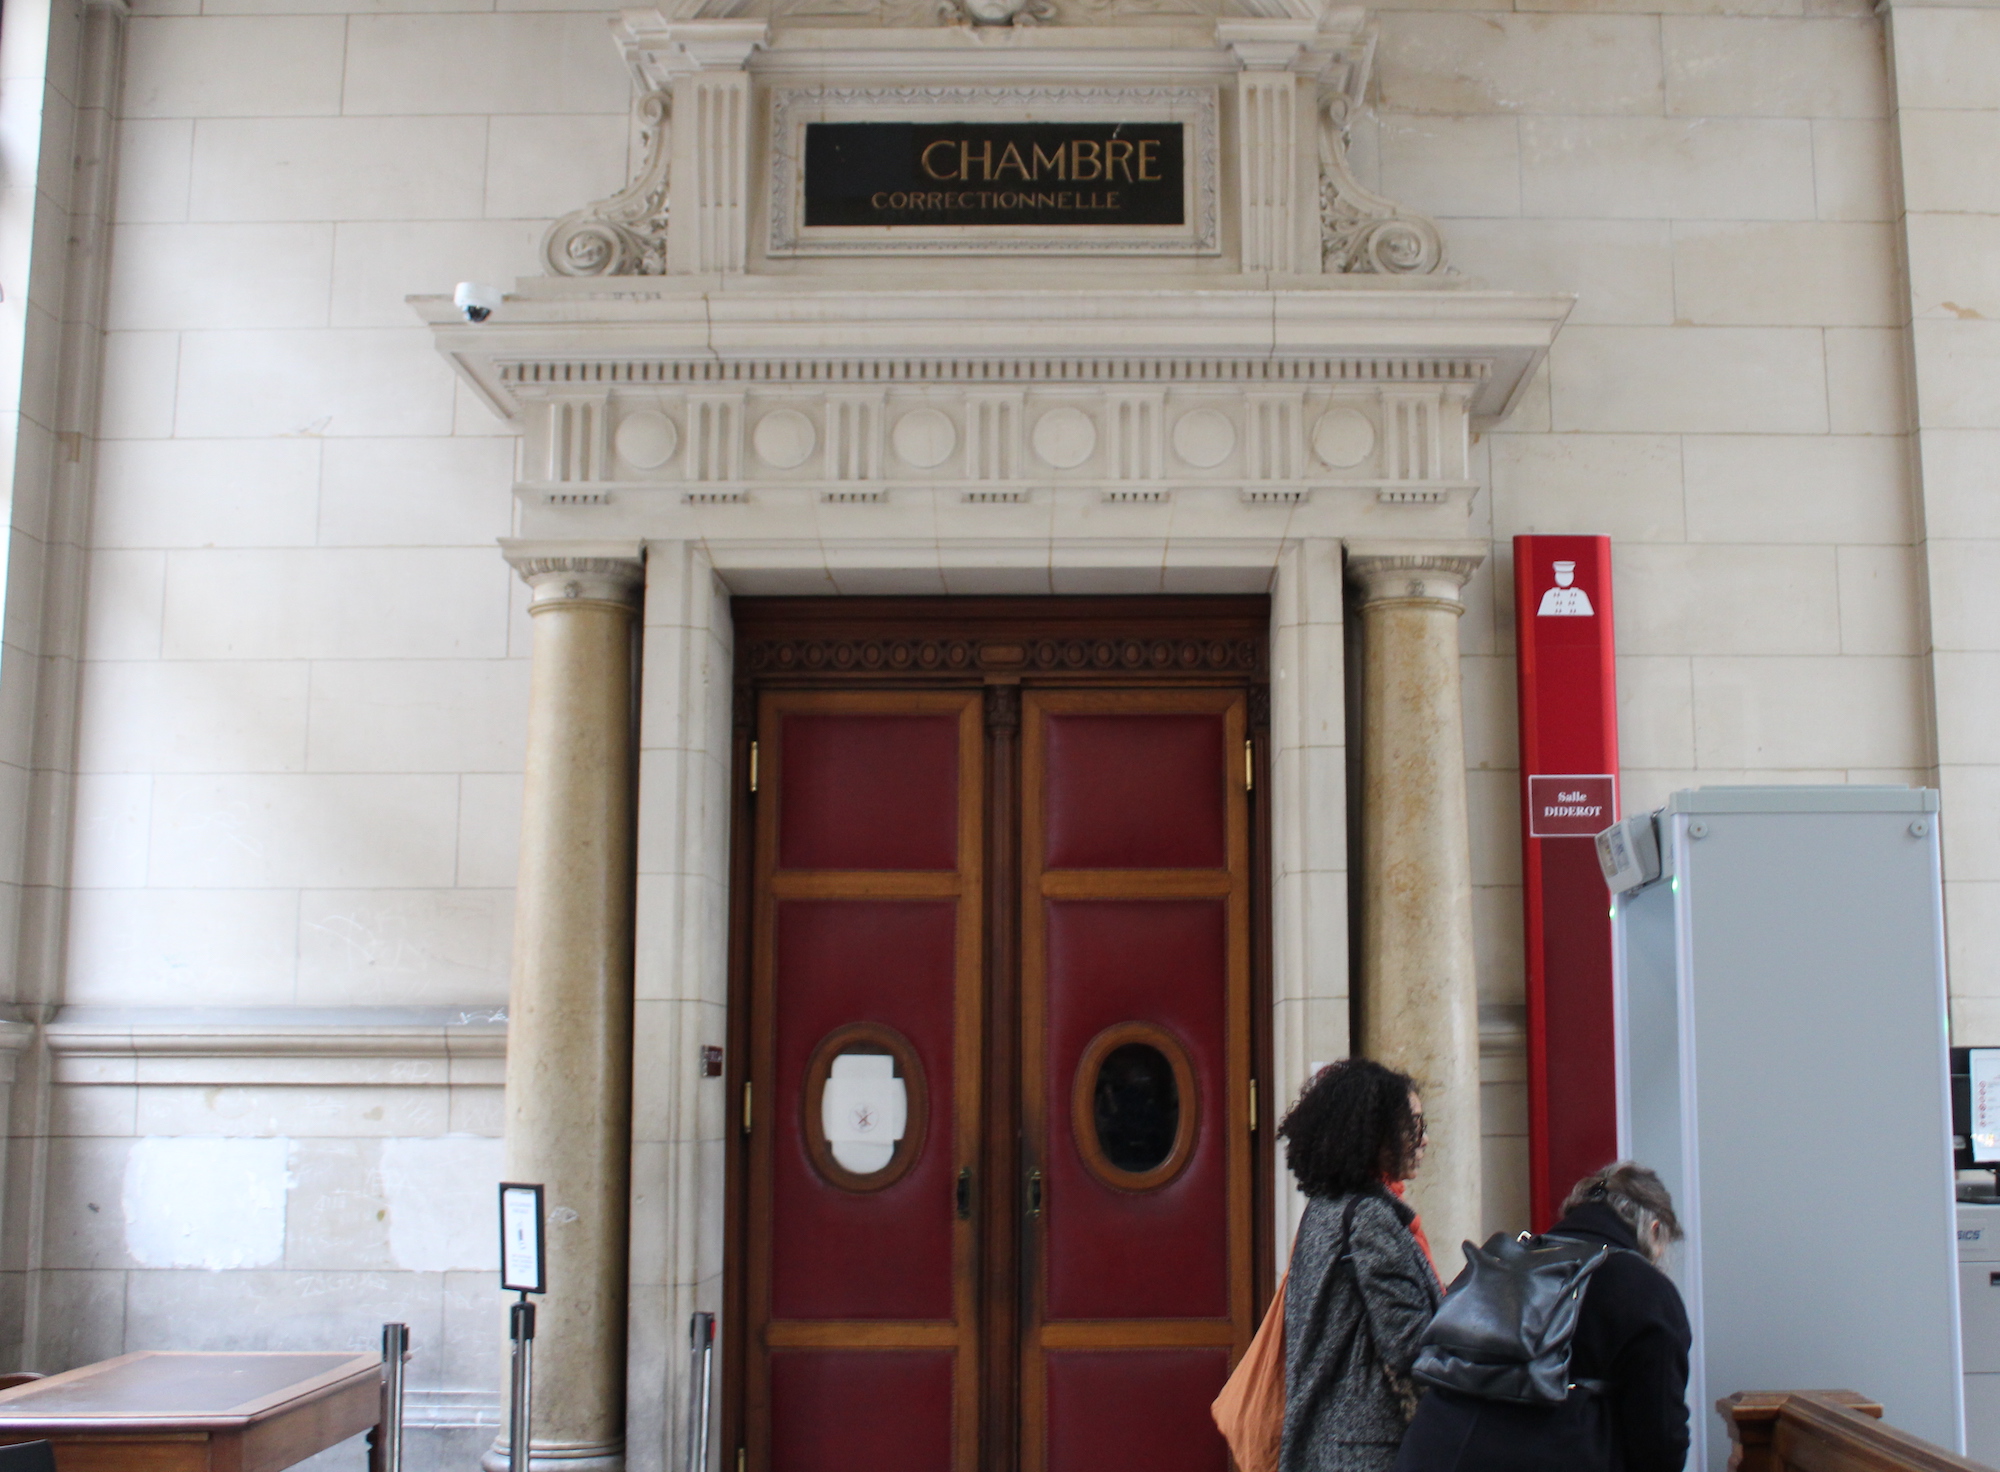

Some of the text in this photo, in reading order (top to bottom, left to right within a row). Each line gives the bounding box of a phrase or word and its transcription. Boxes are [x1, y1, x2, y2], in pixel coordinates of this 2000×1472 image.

[921, 139, 1162, 183] CHAMBRE
[871, 190, 1121, 211] CORRECTIONNELLE
[1557, 791, 1587, 803] Salle
[1543, 805, 1603, 817] DIDEROT
